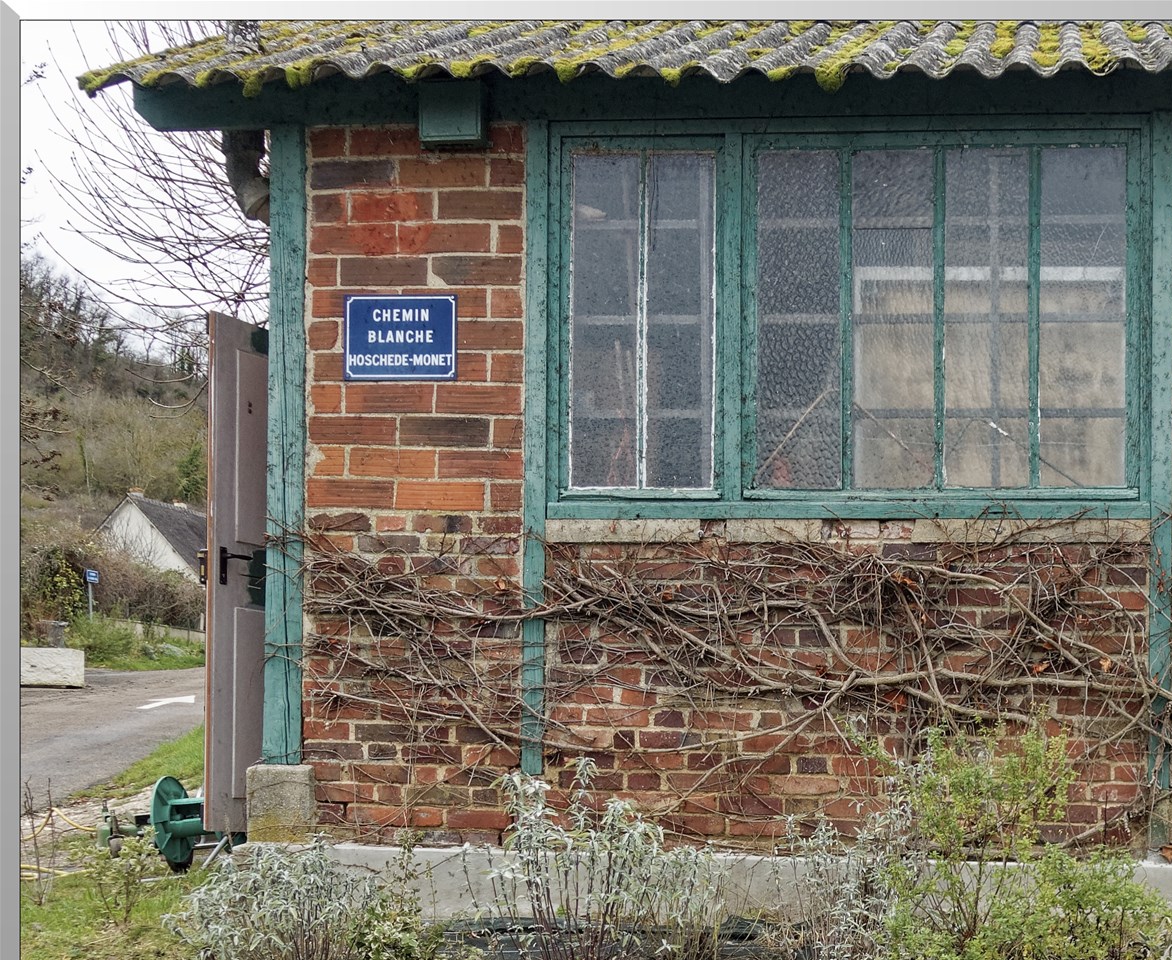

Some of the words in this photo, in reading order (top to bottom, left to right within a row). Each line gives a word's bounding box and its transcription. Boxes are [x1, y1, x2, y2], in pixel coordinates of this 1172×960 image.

[372, 308, 430, 322] CHEMIN
[367, 330, 434, 343] BLANCHE
[348, 354, 453, 366] HOSCHEDE-MONET
